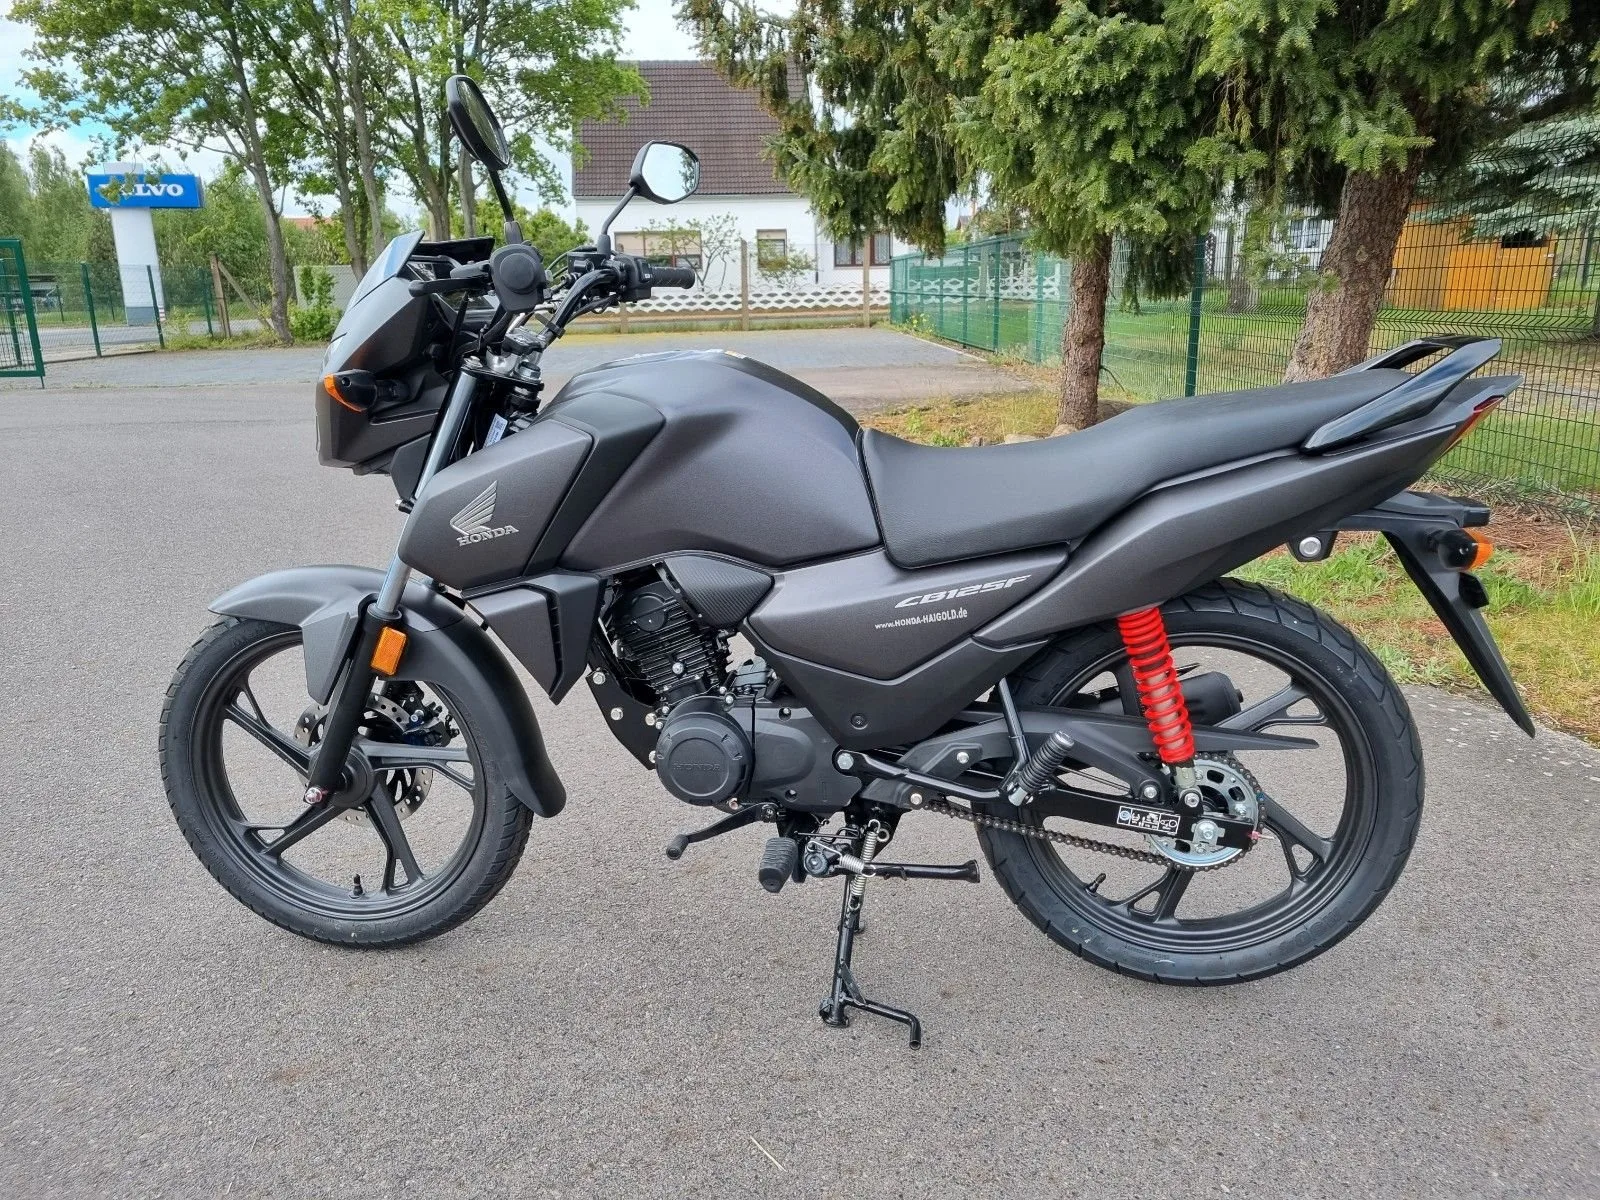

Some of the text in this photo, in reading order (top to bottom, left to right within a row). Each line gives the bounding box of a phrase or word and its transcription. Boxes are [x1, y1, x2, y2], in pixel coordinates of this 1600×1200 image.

[99, 183, 184, 197] LVO
[456, 525, 519, 547] HONDA
[894, 574, 1032, 608] CB125F
[874, 607, 968, 630] www.HONDA-HAIGOLD.de
